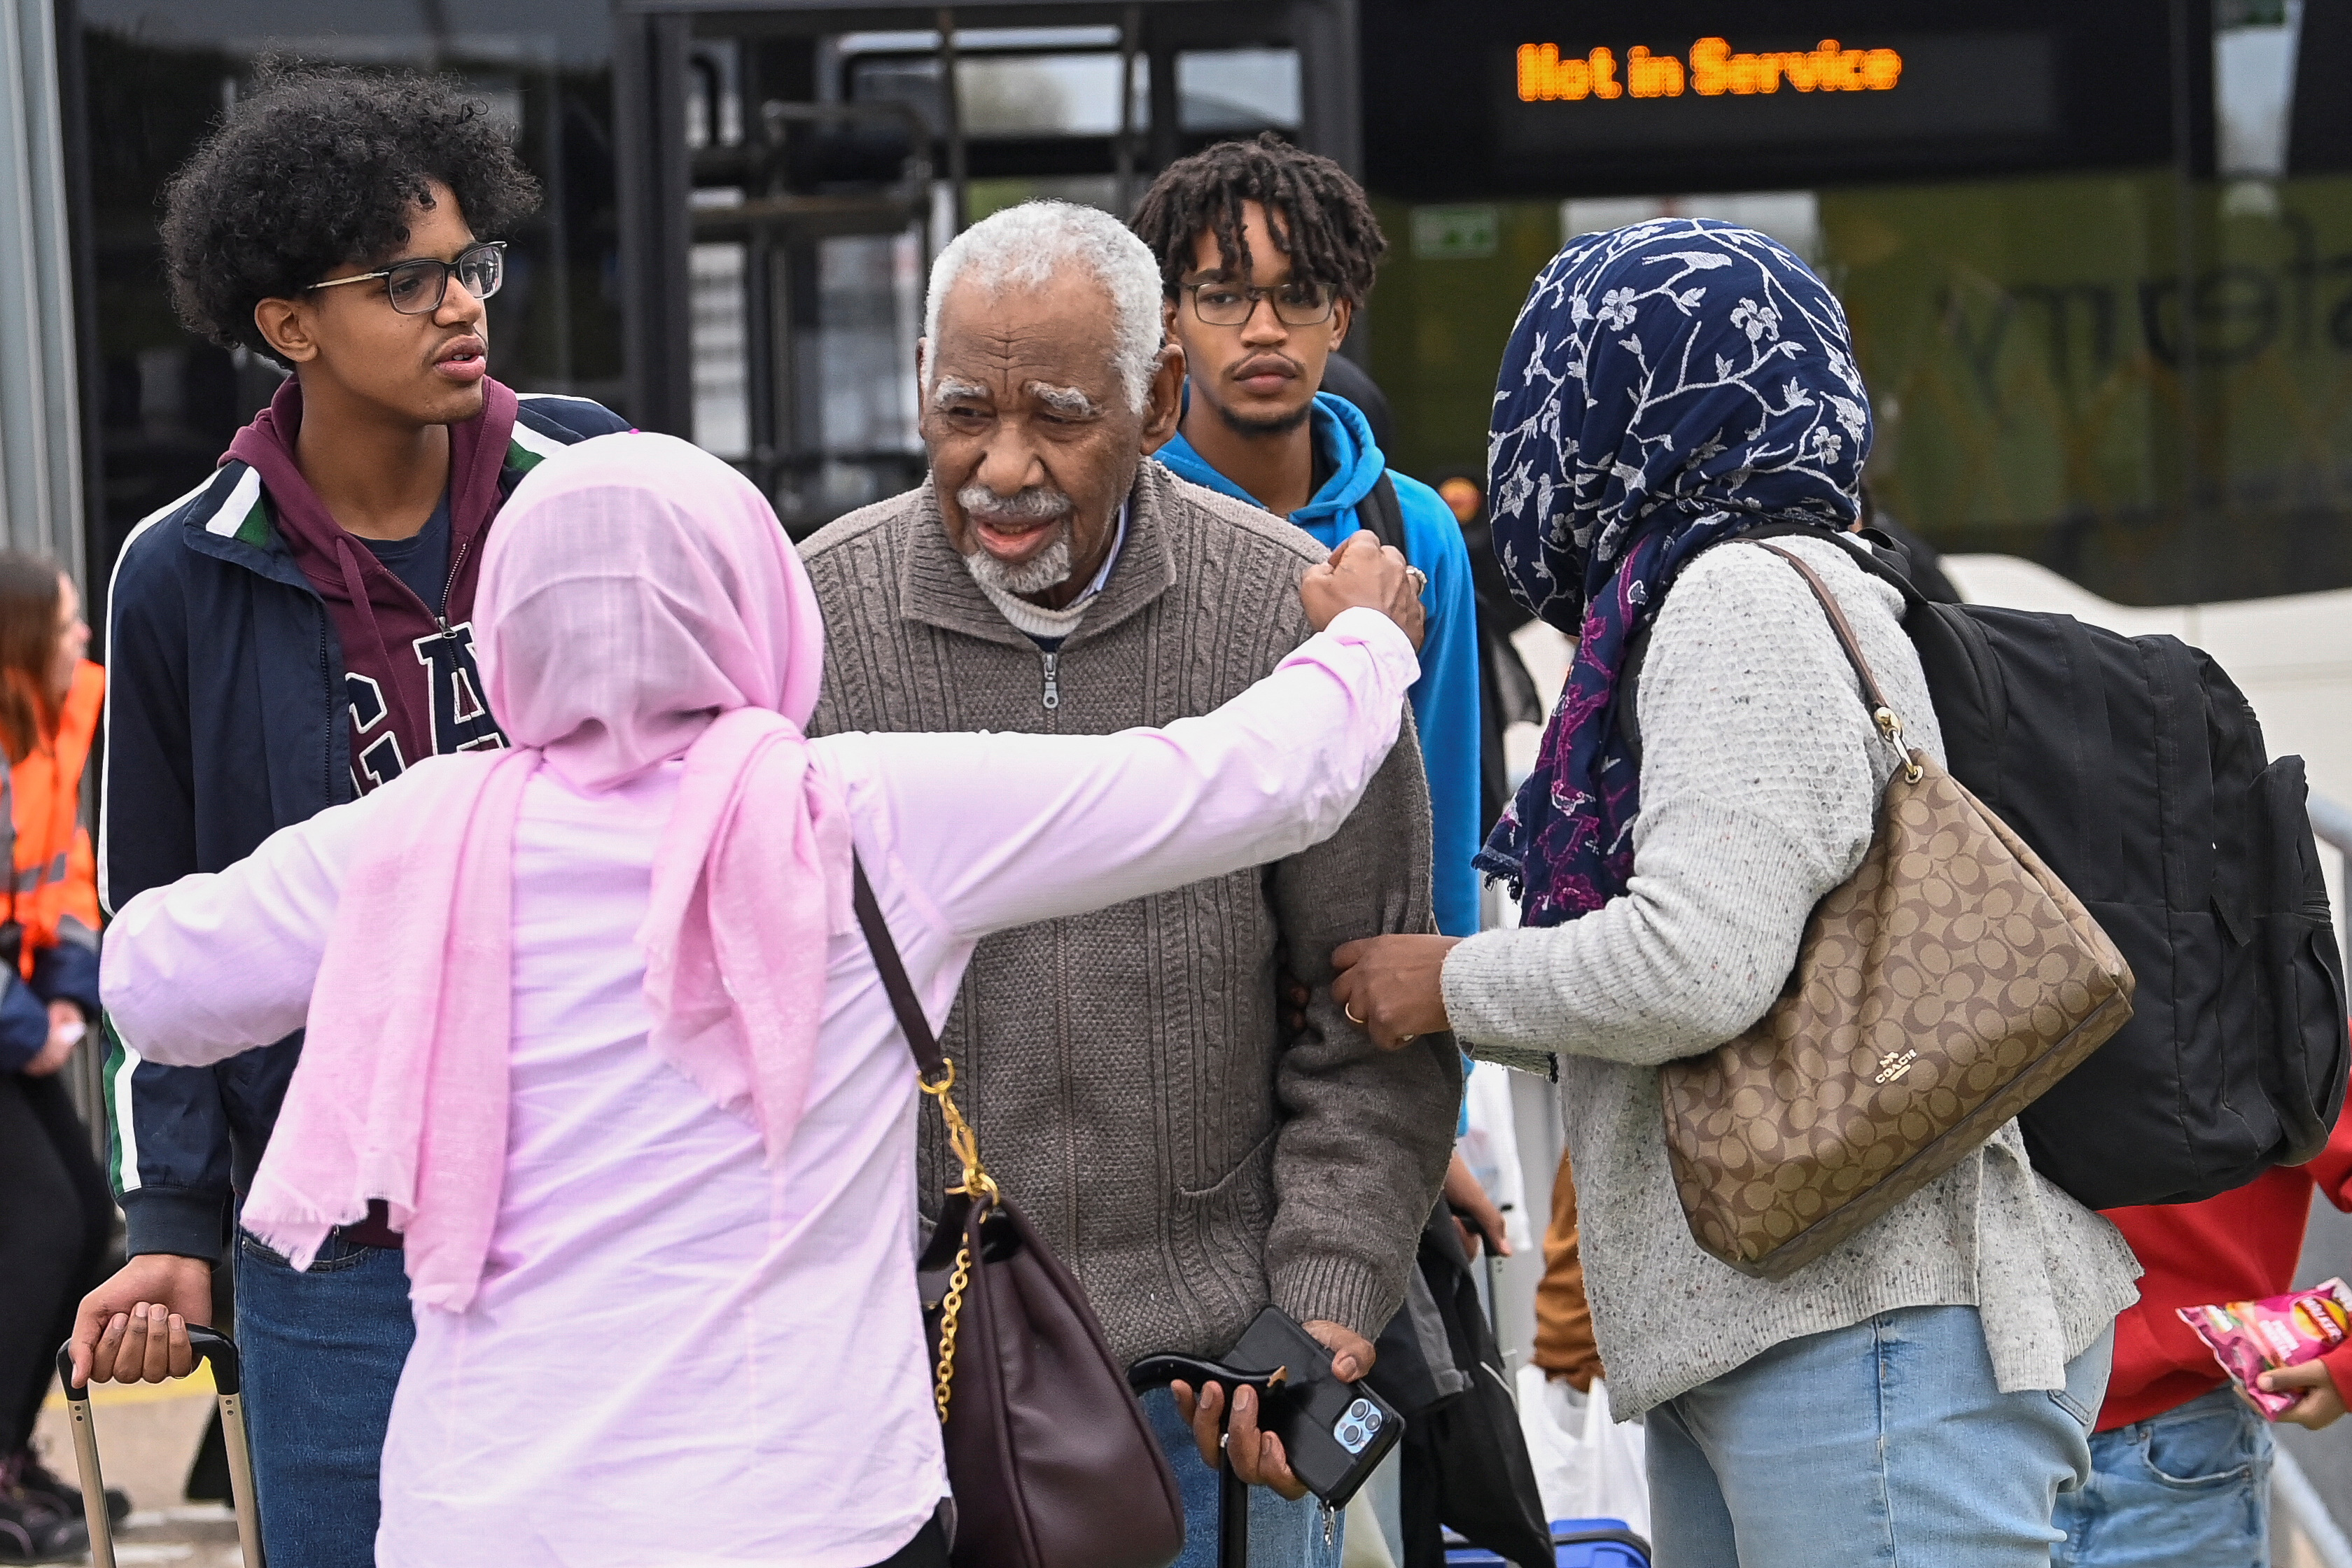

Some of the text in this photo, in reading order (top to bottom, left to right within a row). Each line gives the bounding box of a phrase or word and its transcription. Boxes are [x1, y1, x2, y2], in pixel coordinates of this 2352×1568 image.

[1517, 37, 1902, 102] Not in Service
[1875, 1049, 1917, 1084] COACH
